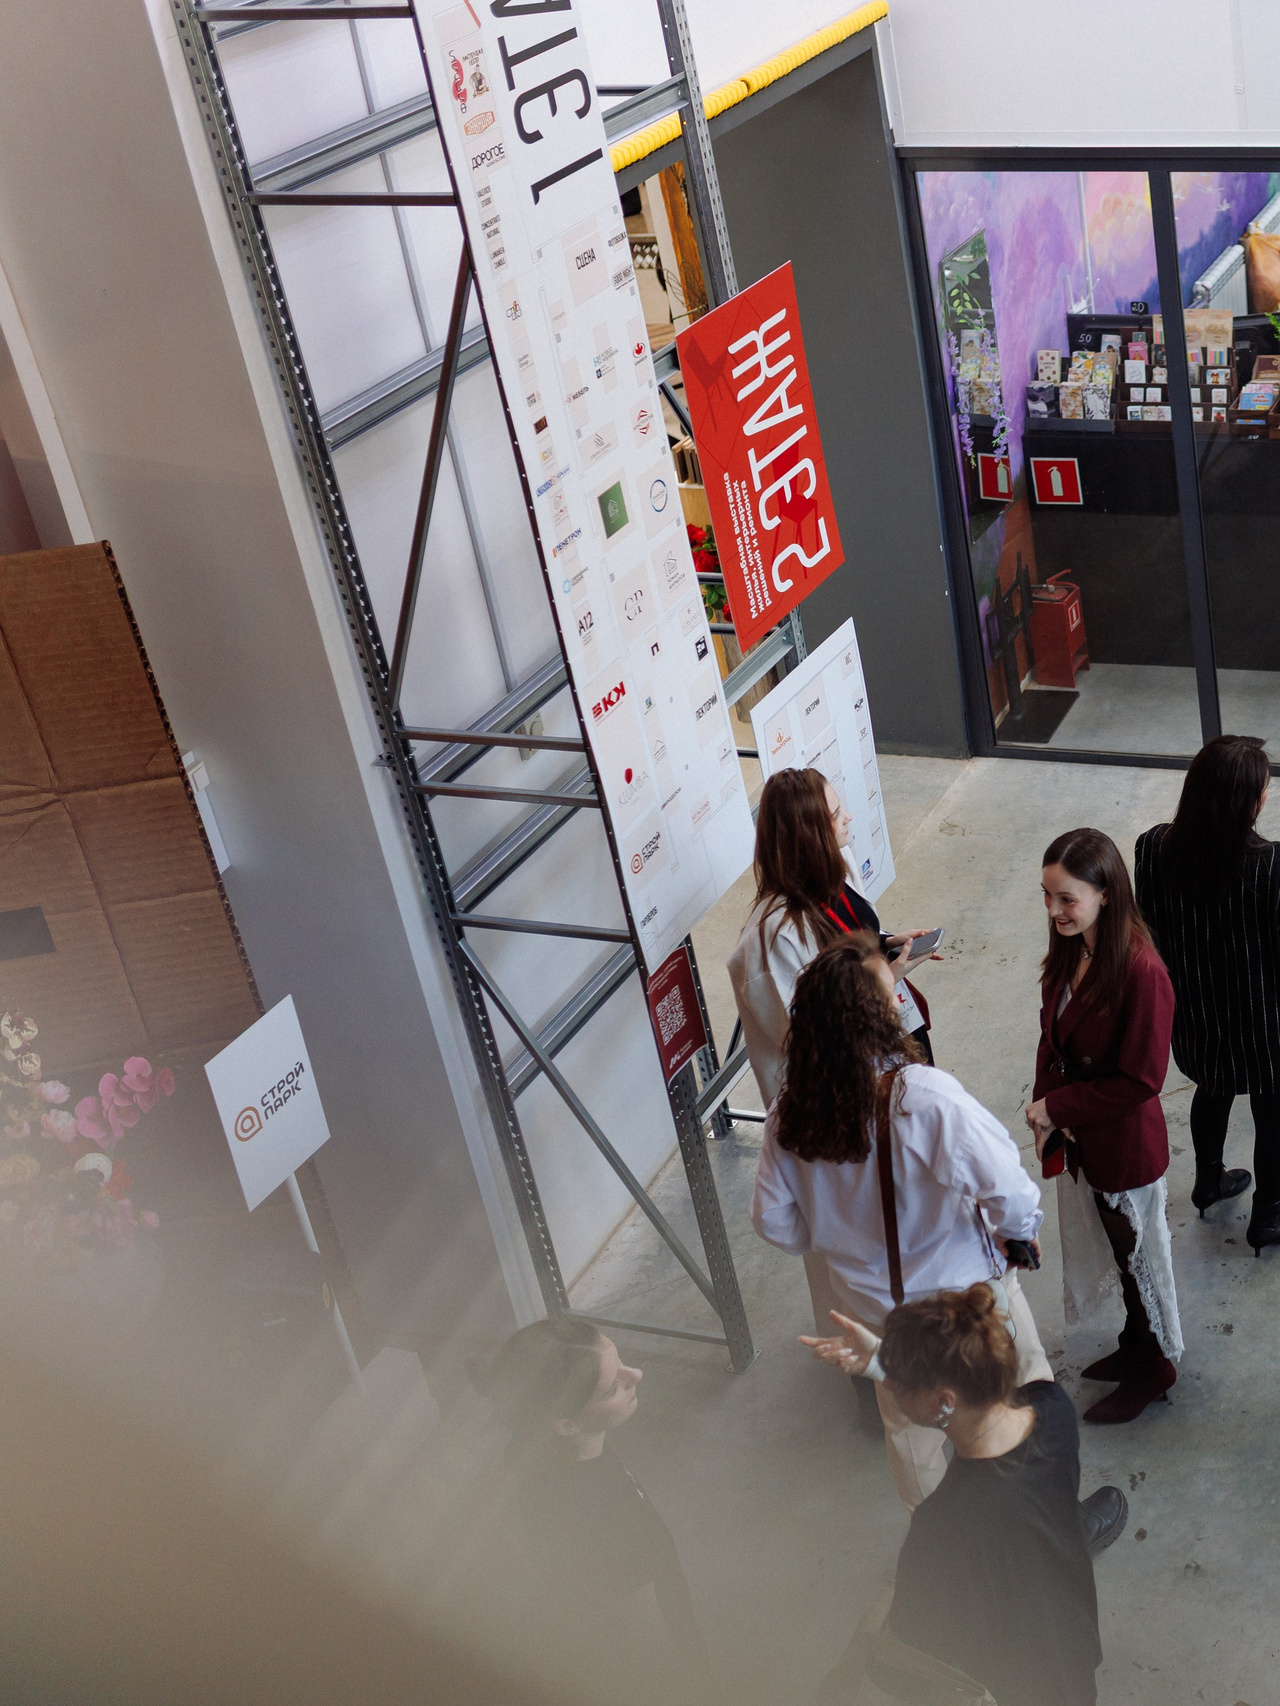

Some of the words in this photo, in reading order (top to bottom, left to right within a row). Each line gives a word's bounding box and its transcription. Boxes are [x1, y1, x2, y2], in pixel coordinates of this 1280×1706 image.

[470, 141, 505, 171] ДОРОГОЕ
[574, 247, 596, 270] СЦЕНА
[1078, 333, 1092, 343] 50
[726, 306, 819, 536] ЭТАЖ
[722, 470, 740, 536] выставка
[731, 478, 754, 567] интерьерных
[739, 478, 756, 537] ремонта
[735, 534, 757, 620] Масштабная
[753, 546, 771, 609] решений
[768, 514, 831, 599] 2
[749, 565, 764, 614] жилья,
[695, 689, 718, 721] ЛЕКТОРИЙ
[641, 829, 660, 856] СТРОЙ
[642, 841, 659, 864] ПАРК
[260, 1061, 305, 1107] СТРОЙ
[263, 1079, 302, 1120] ПАРК
